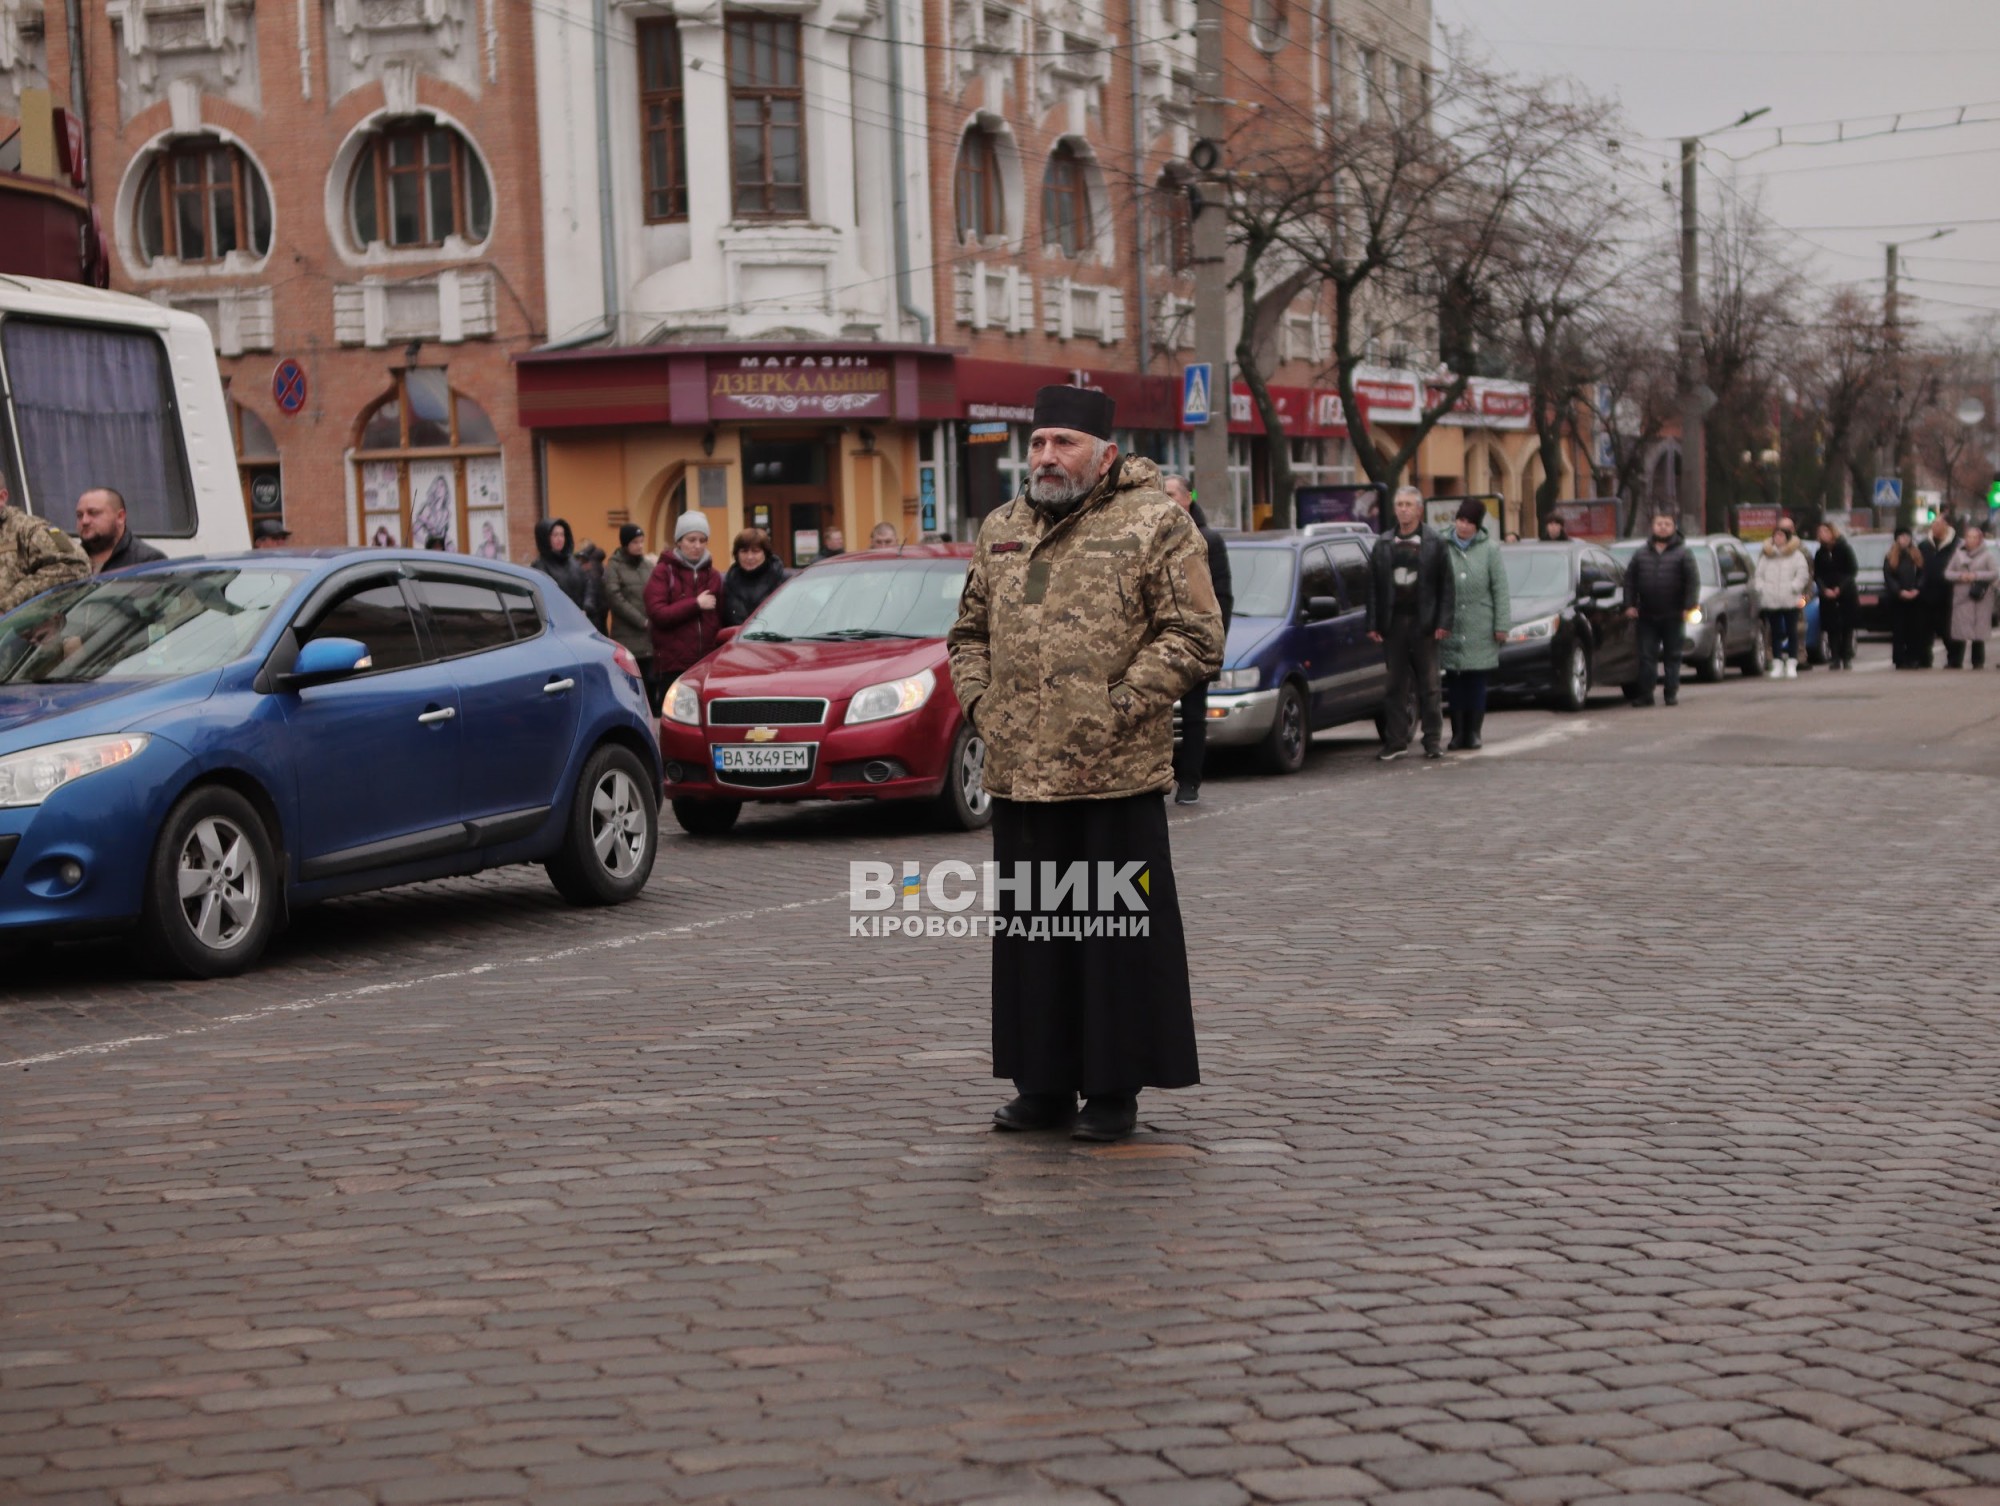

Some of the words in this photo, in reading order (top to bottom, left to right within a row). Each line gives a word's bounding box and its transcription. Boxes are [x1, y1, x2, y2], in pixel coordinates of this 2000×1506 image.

[740, 356, 869, 367] МАГАЗИН
[713, 370, 889, 395] ДЗЕРКАЛЬНИЙ
[723, 751, 744, 766] BA
[747, 751, 780, 766] 3649
[783, 751, 805, 766] EM
